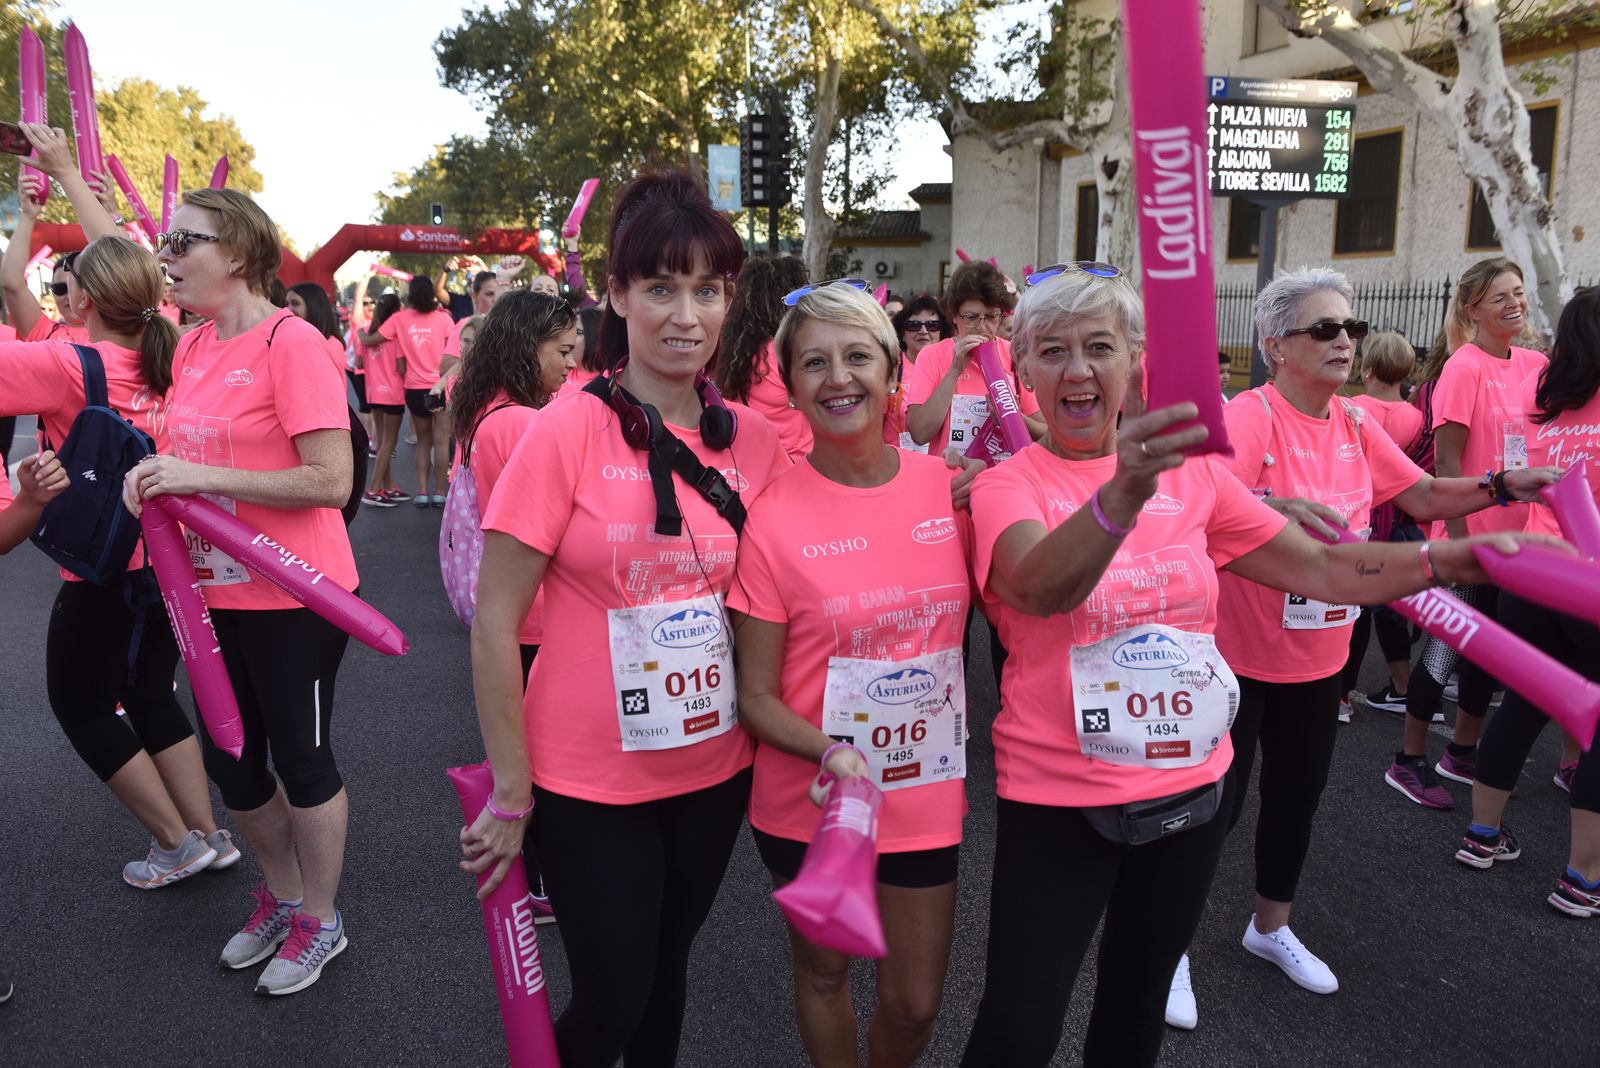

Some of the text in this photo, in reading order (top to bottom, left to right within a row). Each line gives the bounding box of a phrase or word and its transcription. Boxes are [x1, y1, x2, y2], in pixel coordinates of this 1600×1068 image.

[1212, 78, 1224, 96] P
[1220, 107, 1351, 129] PLAZA NUEVA 154
[1219, 128, 1300, 149] MAGDALENA
[1218, 150, 1271, 170] ARJONA
[1219, 170, 1259, 190] TORRE
[1261, 172, 1310, 192] SEVILLA
[1136, 125, 1197, 279] Ladival
[416, 230, 463, 243] Santan
[989, 378, 1017, 418] Ladival
[602, 465, 651, 481] OYSH
[607, 524, 638, 542] HOY
[186, 534, 212, 552] 016
[803, 536, 868, 558] OYSHO
[659, 552, 696, 562] VITORIA
[676, 562, 714, 574] MADRID
[1108, 568, 1147, 580] VITORIA
[1155, 560, 1188, 575] GASTEIZ
[1132, 576, 1168, 590] MADRID
[822, 585, 906, 617] HOY GANAN
[877, 608, 914, 625] VITORIA
[923, 601, 960, 615] GASTEIZ
[1401, 589, 1480, 650] Ladiv
[658, 624, 718, 642] ASTURIANA
[898, 616, 936, 632] MADRID
[1119, 649, 1185, 664] ASTURIANA
[665, 664, 720, 697] 016
[1171, 668, 1200, 678] Carrera
[873, 681, 931, 697] ASTURIANA
[683, 697, 712, 713] 1493
[1126, 690, 1193, 718] 016
[630, 727, 668, 738] OYSHO
[872, 720, 927, 748] 016
[1146, 723, 1179, 736] 1494
[886, 749, 913, 763] 1495
[1089, 743, 1185, 755] OYSHO Santander
[933, 766, 956, 775] ZURICH
